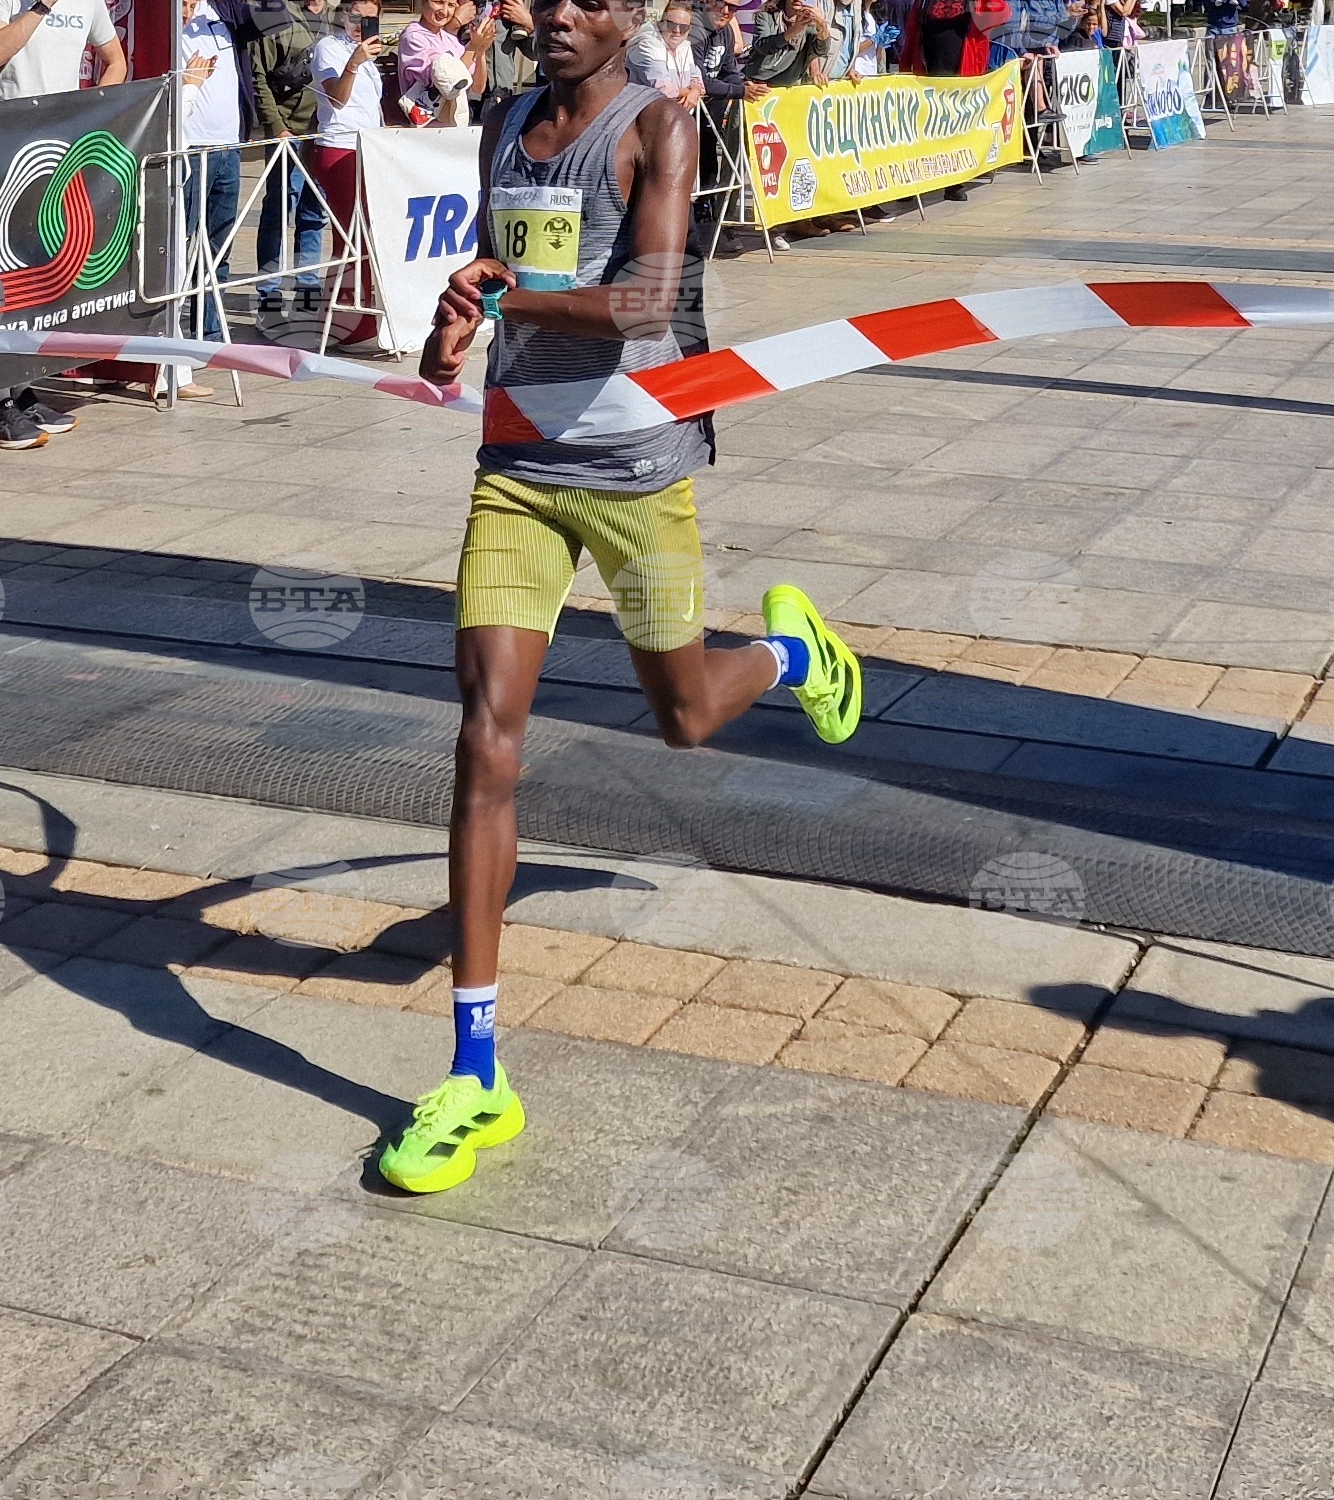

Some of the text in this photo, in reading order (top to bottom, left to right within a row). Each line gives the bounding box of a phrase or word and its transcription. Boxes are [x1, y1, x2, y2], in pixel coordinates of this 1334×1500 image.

[807, 85, 990, 164] ОБЩИНСКИ ПАЗАРИ
[504, 219, 529, 259] 18
[32, 307, 67, 332] лека
[71, 288, 136, 320] атлетика
